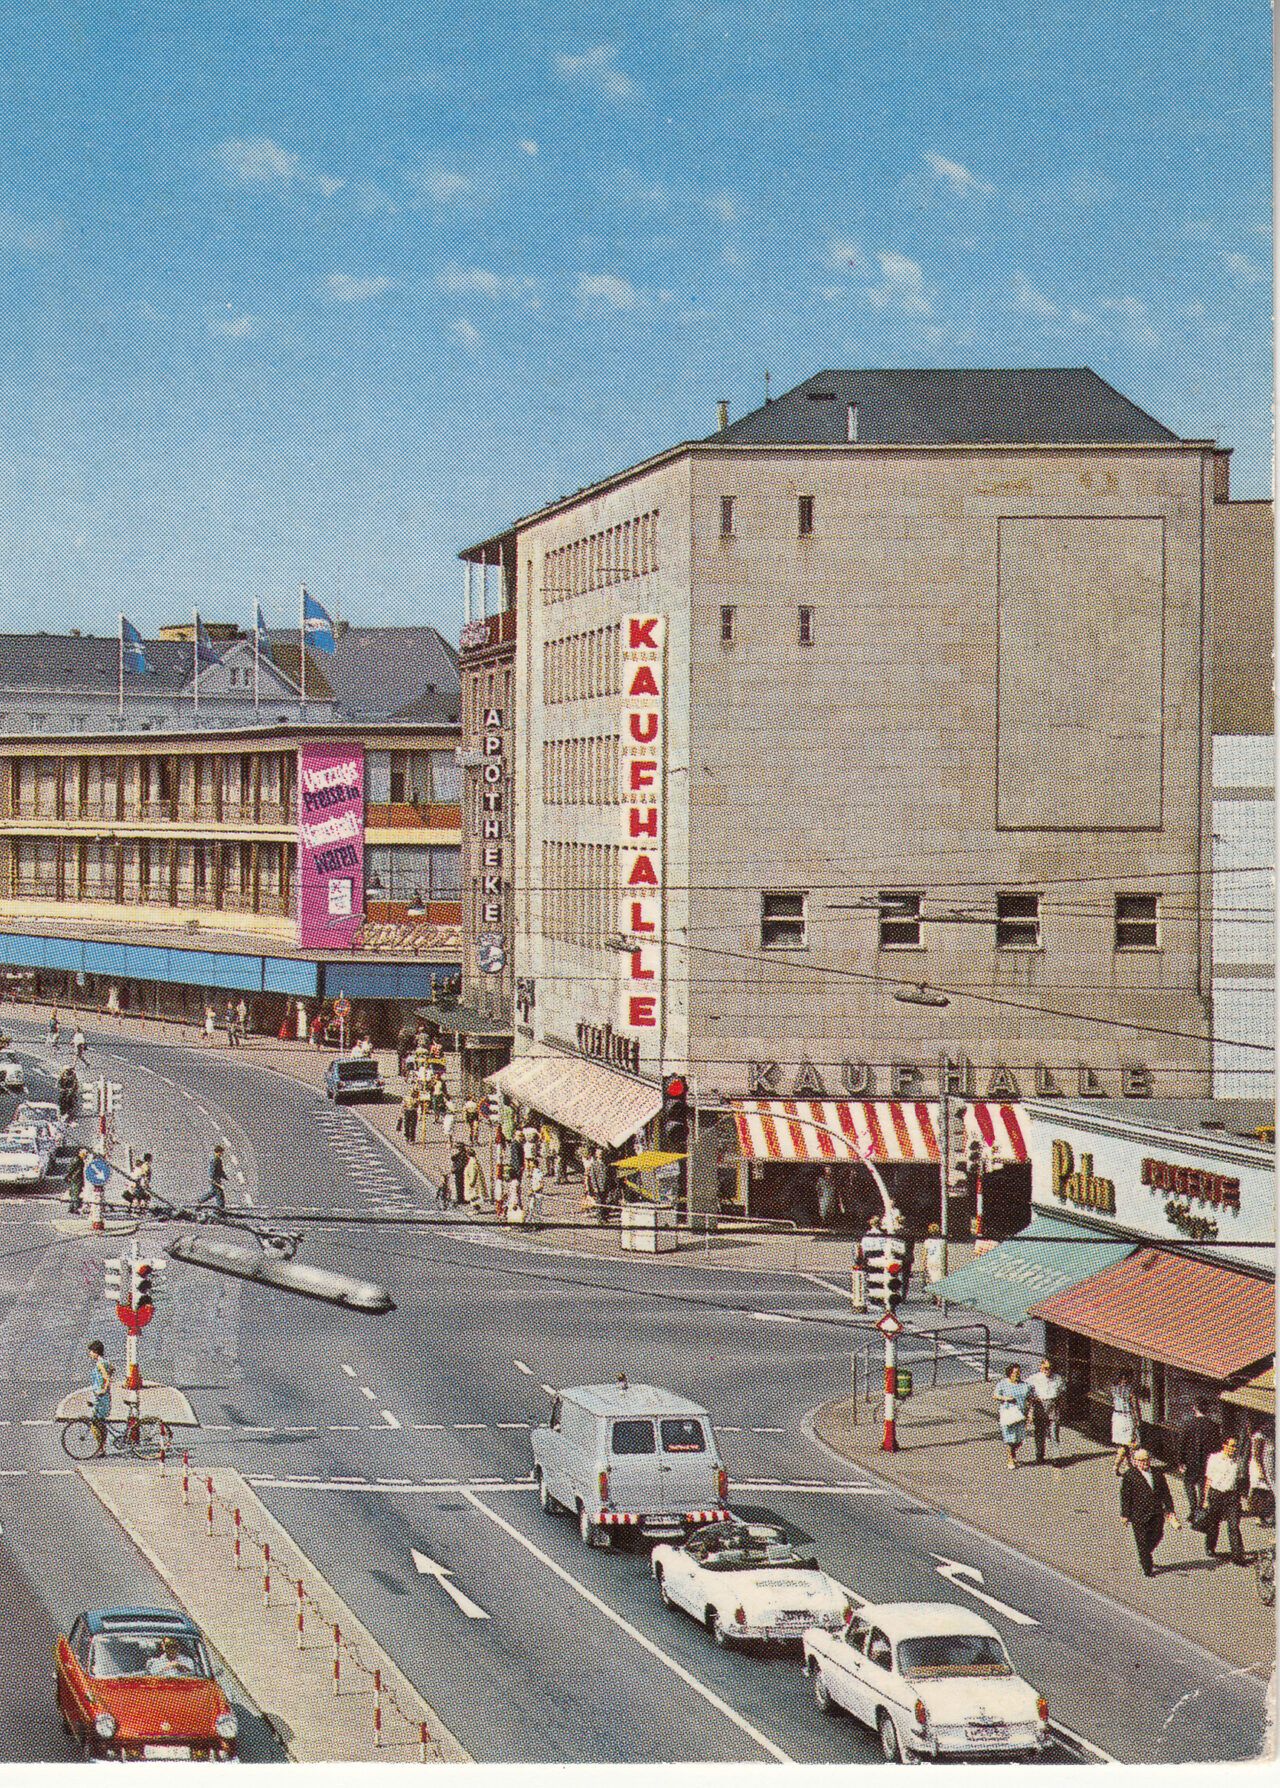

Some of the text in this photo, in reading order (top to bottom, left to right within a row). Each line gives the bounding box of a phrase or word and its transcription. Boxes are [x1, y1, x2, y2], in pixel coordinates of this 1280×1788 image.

[483, 709, 504, 922] APOTHEKE
[628, 617, 660, 1028] KAUFHALLE
[749, 1054, 1154, 1098] KAUFHALLE
[1052, 1139, 1116, 1214] Palm
